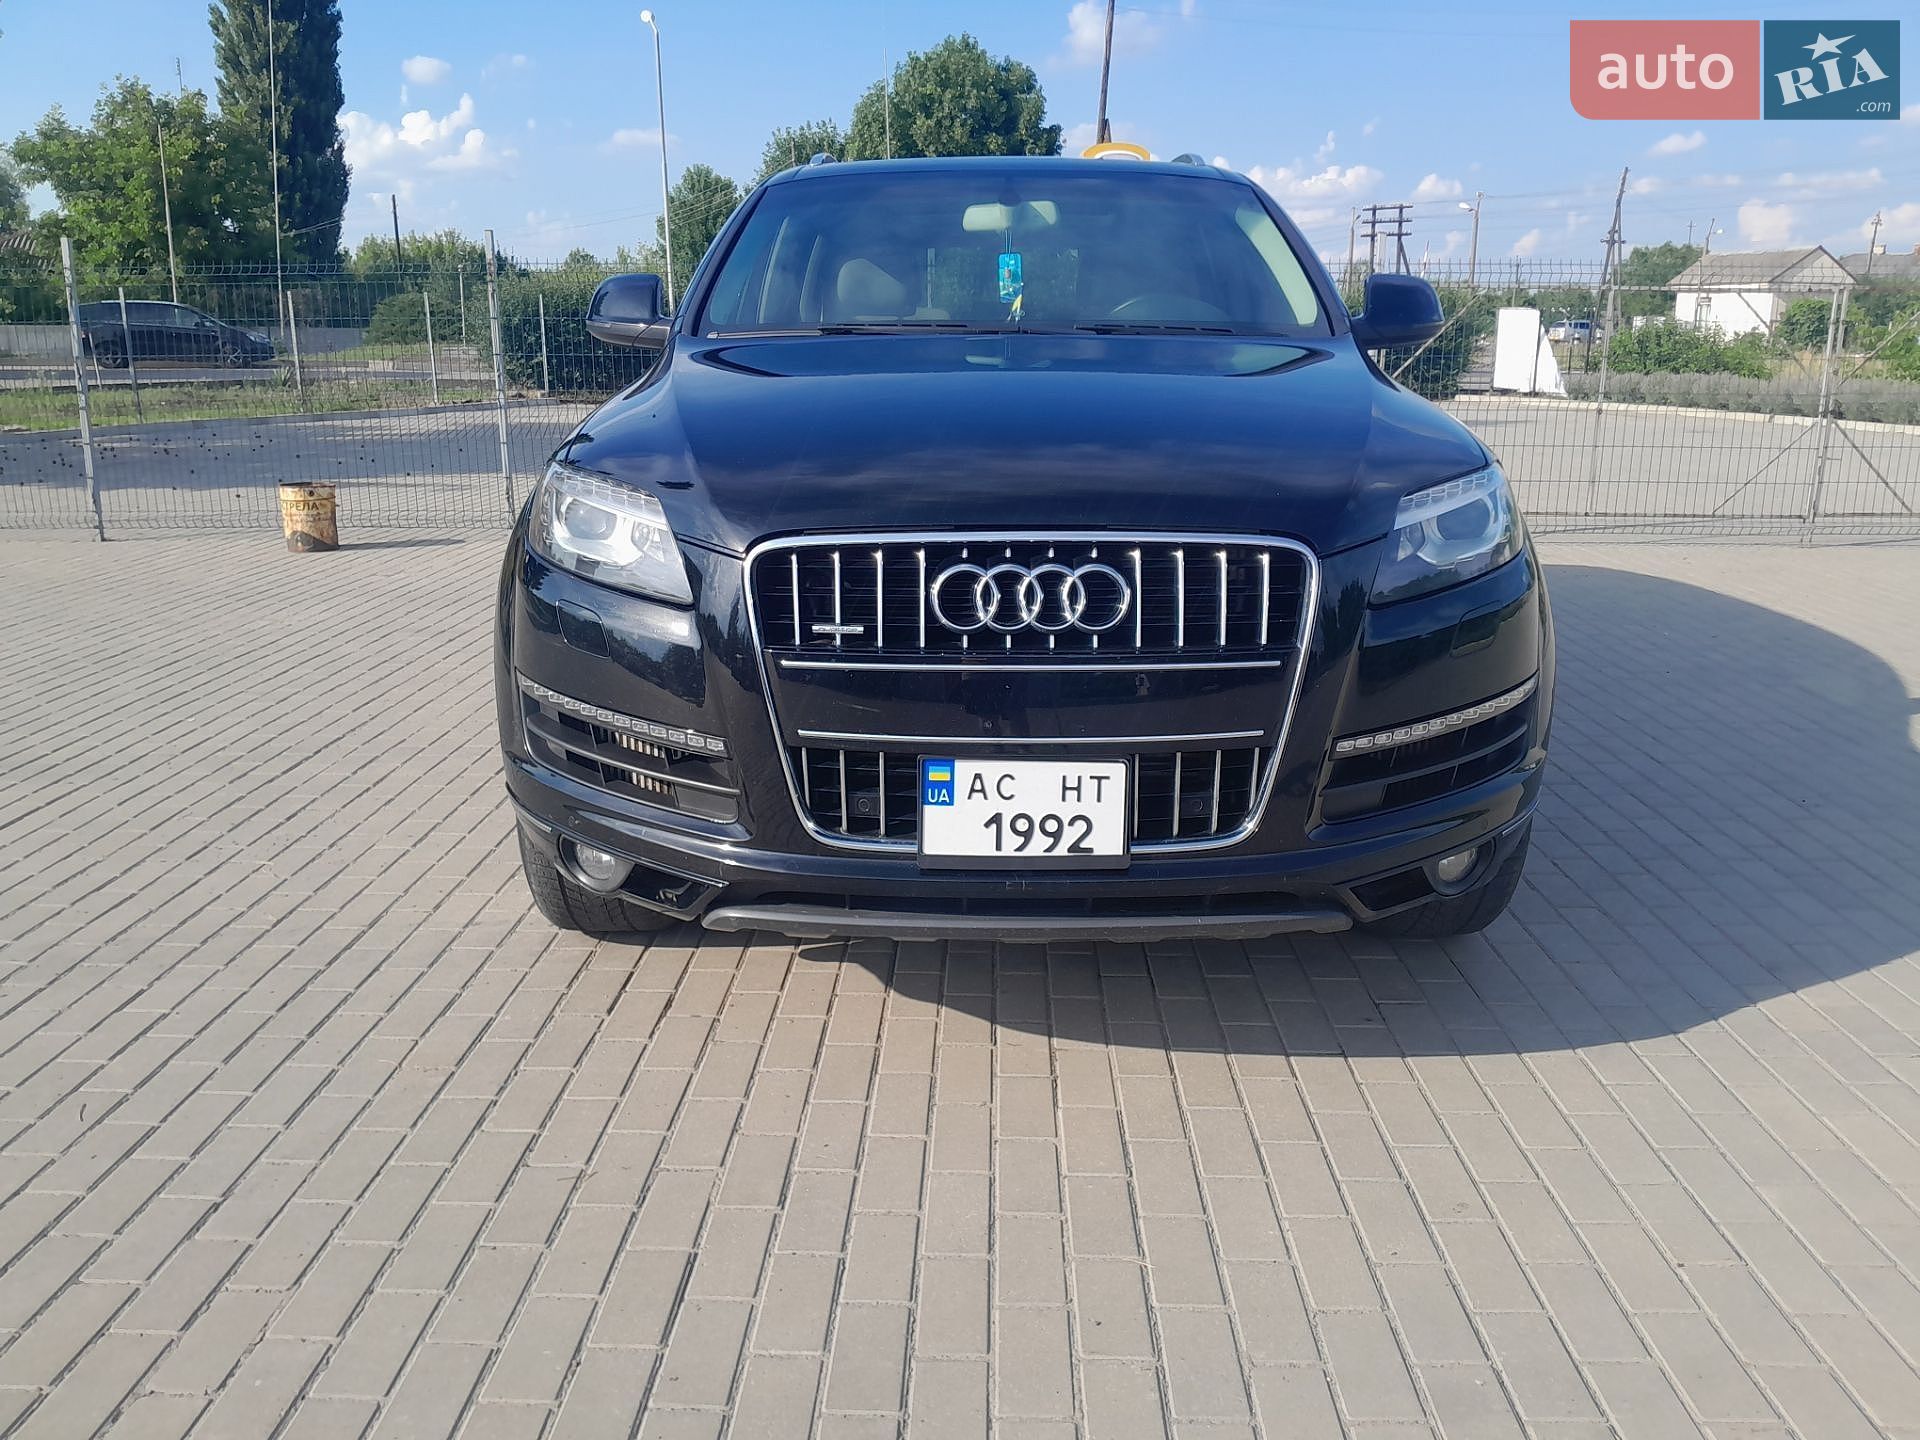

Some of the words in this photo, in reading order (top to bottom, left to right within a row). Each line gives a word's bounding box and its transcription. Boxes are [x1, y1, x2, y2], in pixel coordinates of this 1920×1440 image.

[928, 788, 950, 804] UA
[967, 773, 1016, 801] AC
[1061, 775, 1111, 803] HT
[983, 812, 1094, 854] 1992
